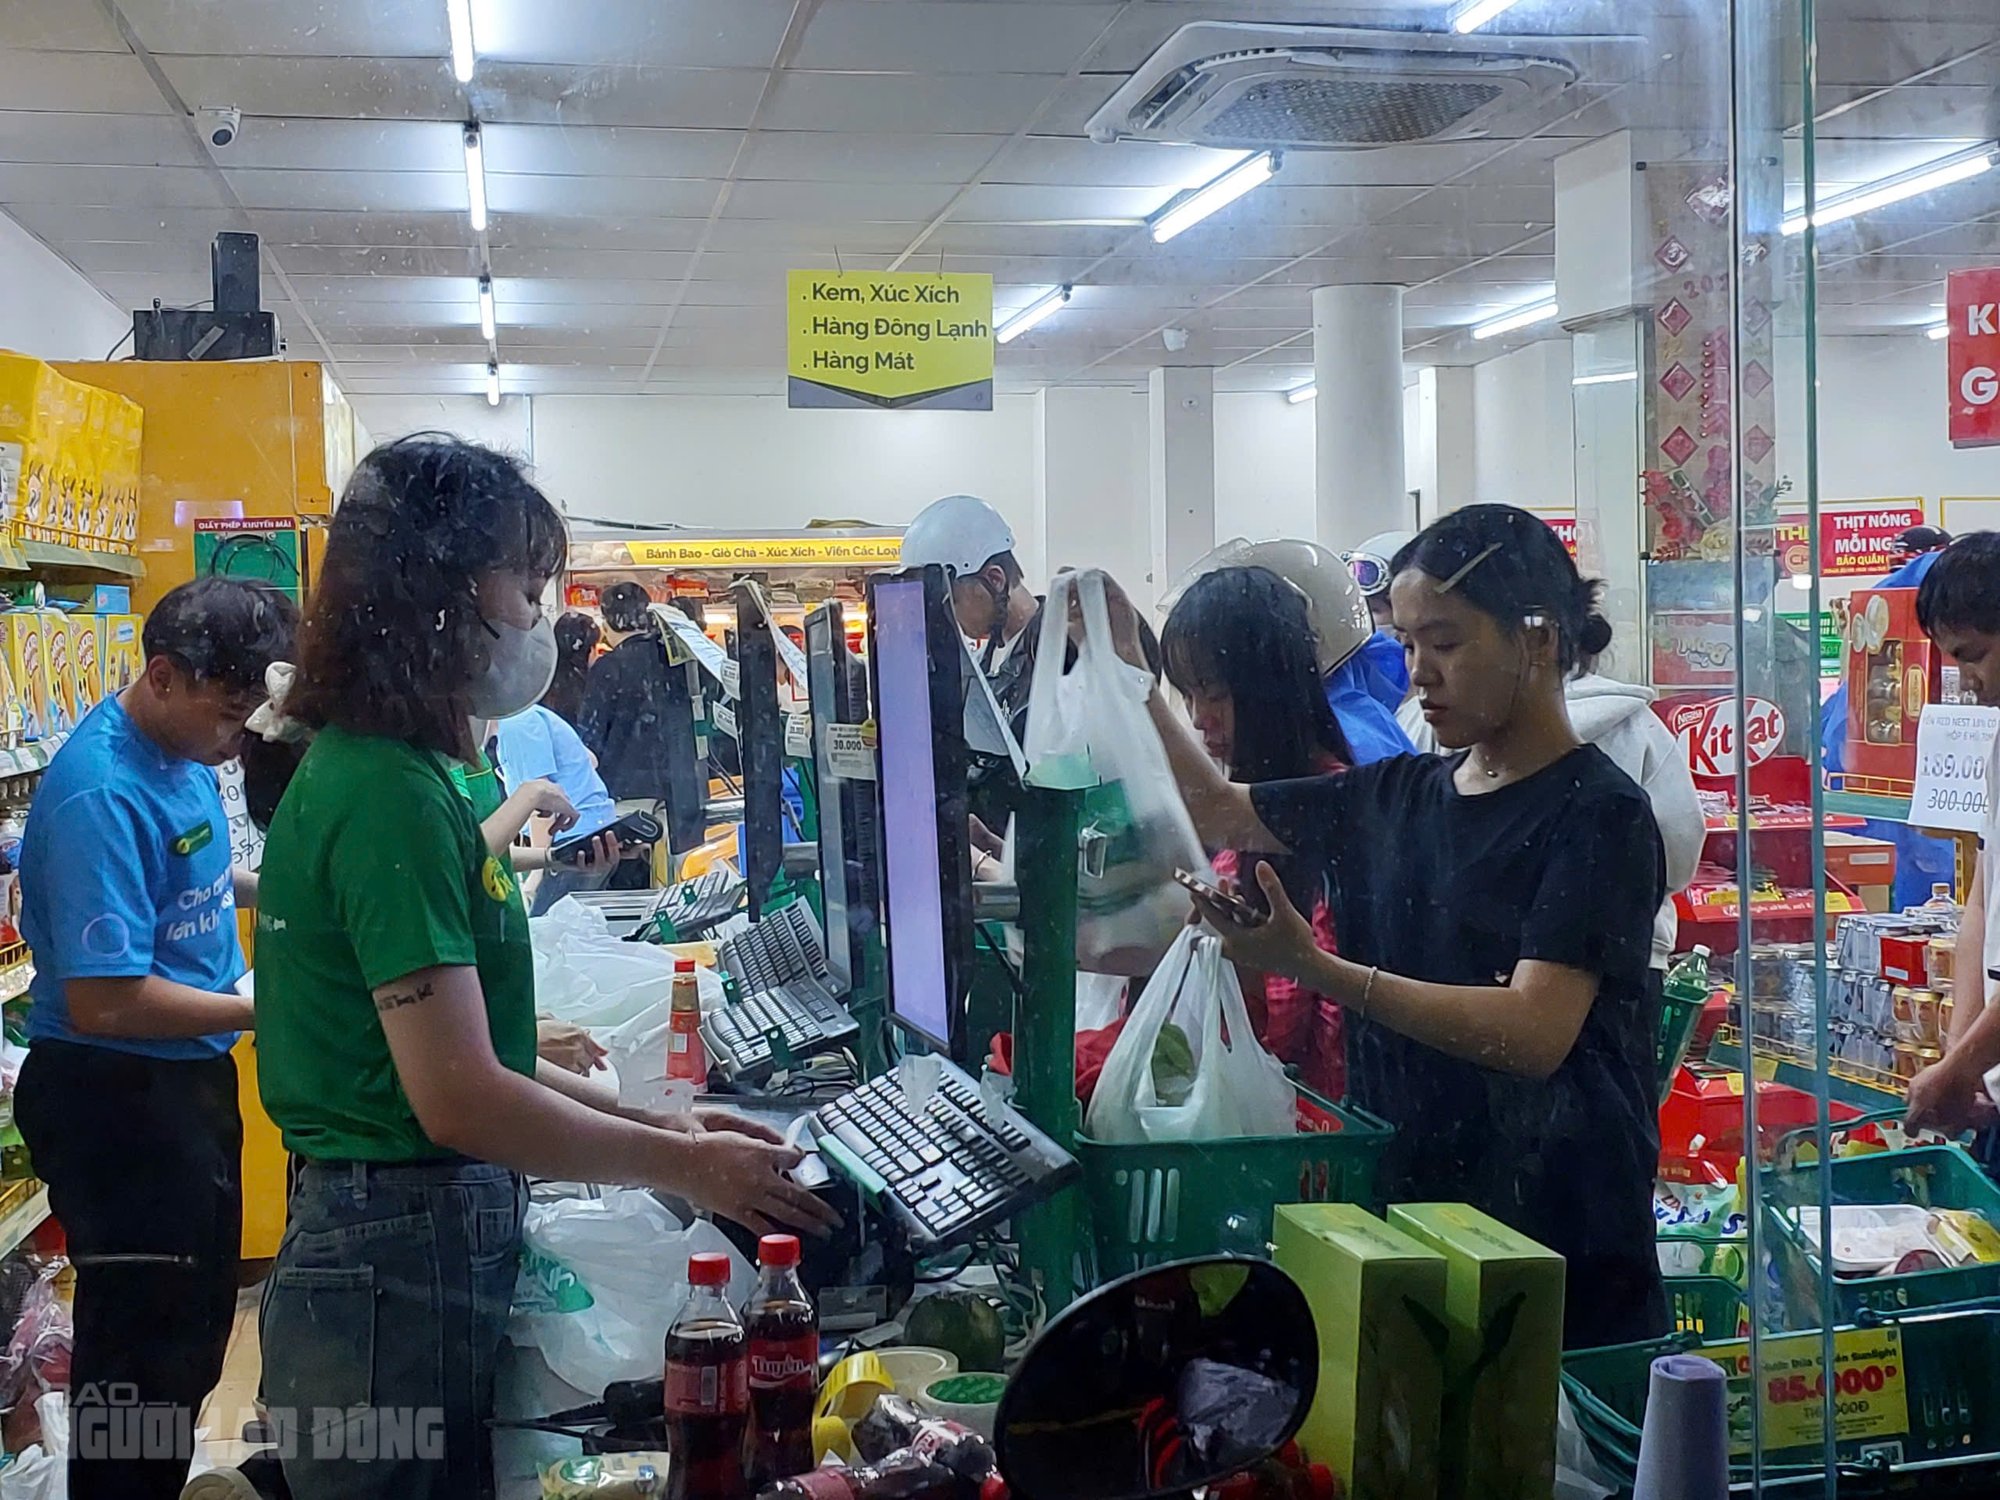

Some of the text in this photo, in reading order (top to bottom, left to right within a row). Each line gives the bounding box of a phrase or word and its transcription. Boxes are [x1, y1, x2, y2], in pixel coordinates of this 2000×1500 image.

[812, 282, 959, 304] Kem, Xúc Xích
[813, 316, 987, 341] Hàng Đông Lạnh
[1968, 303, 2000, 336] K
[813, 350, 915, 374] Hàng Mát
[1833, 512, 1912, 532] THỊT NÓNG
[646, 548, 677, 559] Bánh
[679, 548, 702, 558] Bao
[711, 547, 731, 558] Giò
[766, 547, 788, 557] Xúc
[790, 546, 815, 557] Xích
[852, 545, 874, 556] Các
[1835, 533, 1899, 553] MỖI NG
[1952, 717, 1971, 727] NEST
[833, 739, 862, 751] 30.000
[1921, 753, 1986, 780] 189.00
[1927, 788, 1988, 814] 300.00
[1851, 1347, 1898, 1362] Sunlight
